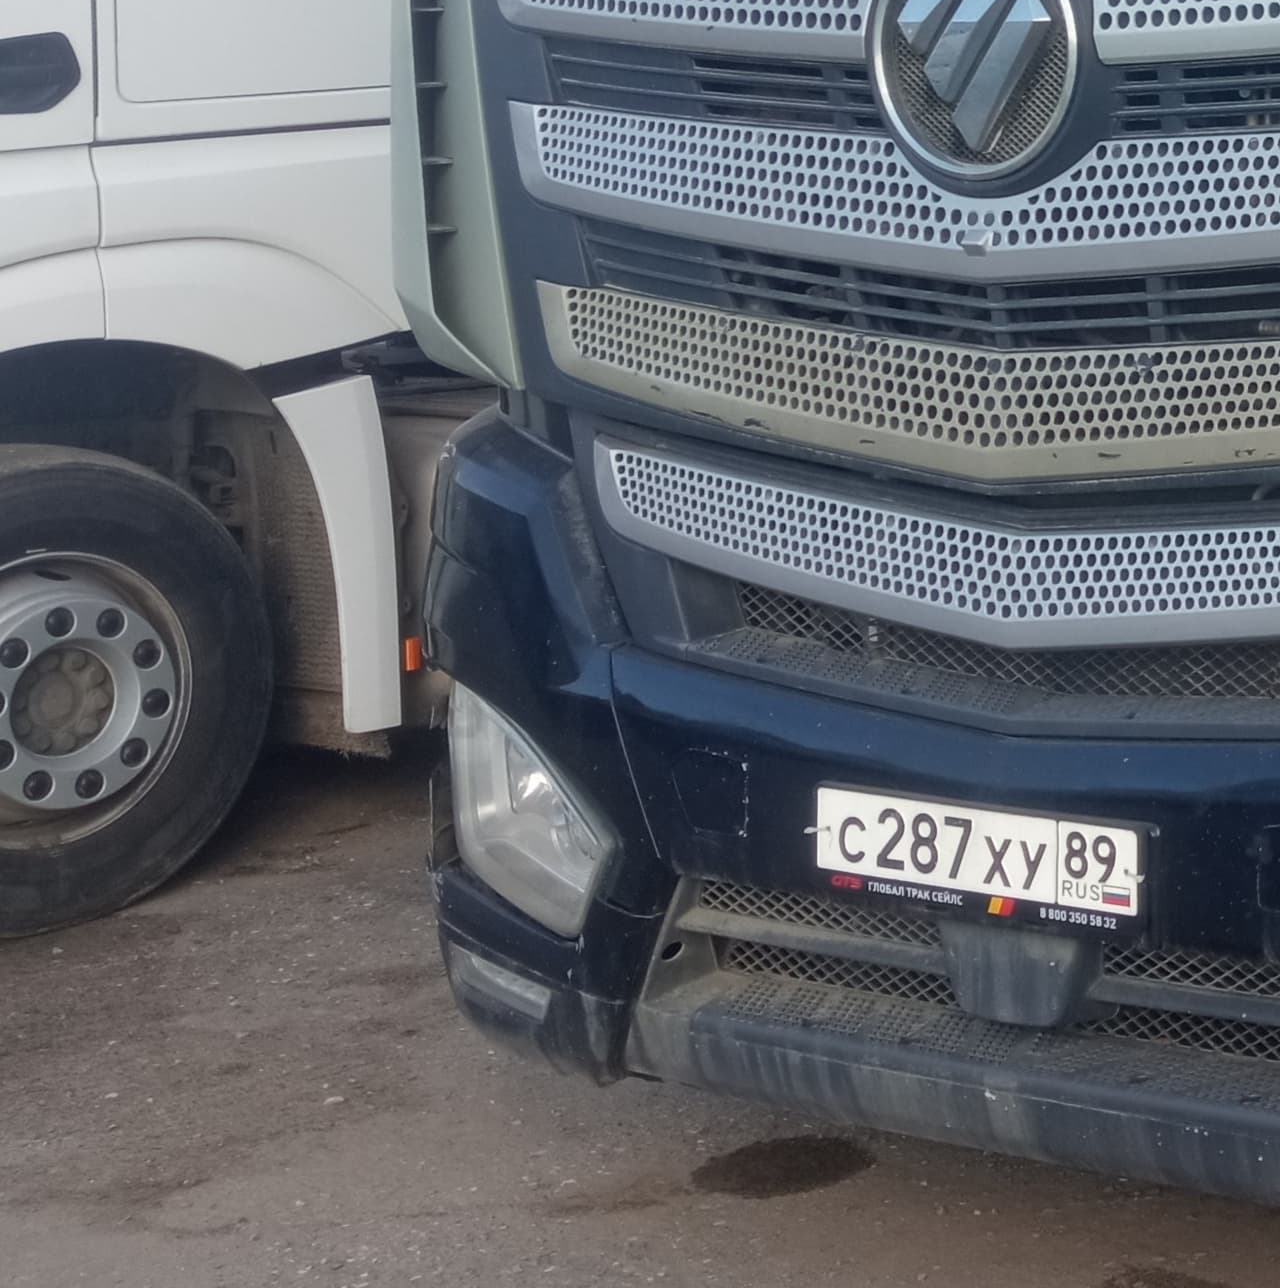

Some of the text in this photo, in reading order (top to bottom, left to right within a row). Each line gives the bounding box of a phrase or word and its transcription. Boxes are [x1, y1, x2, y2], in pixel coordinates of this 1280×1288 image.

[1063, 830, 1118, 884] 89
[868, 881, 904, 897] ГЛОБАЛ
[906, 887, 931, 901] ТРАК
[931, 891, 963, 906] СЕЙЛС
[1062, 879, 1101, 902] RUS
[1048, 908, 1067, 922] 800
[1068, 911, 1088, 925] 350
[1103, 917, 1117, 930] 32
